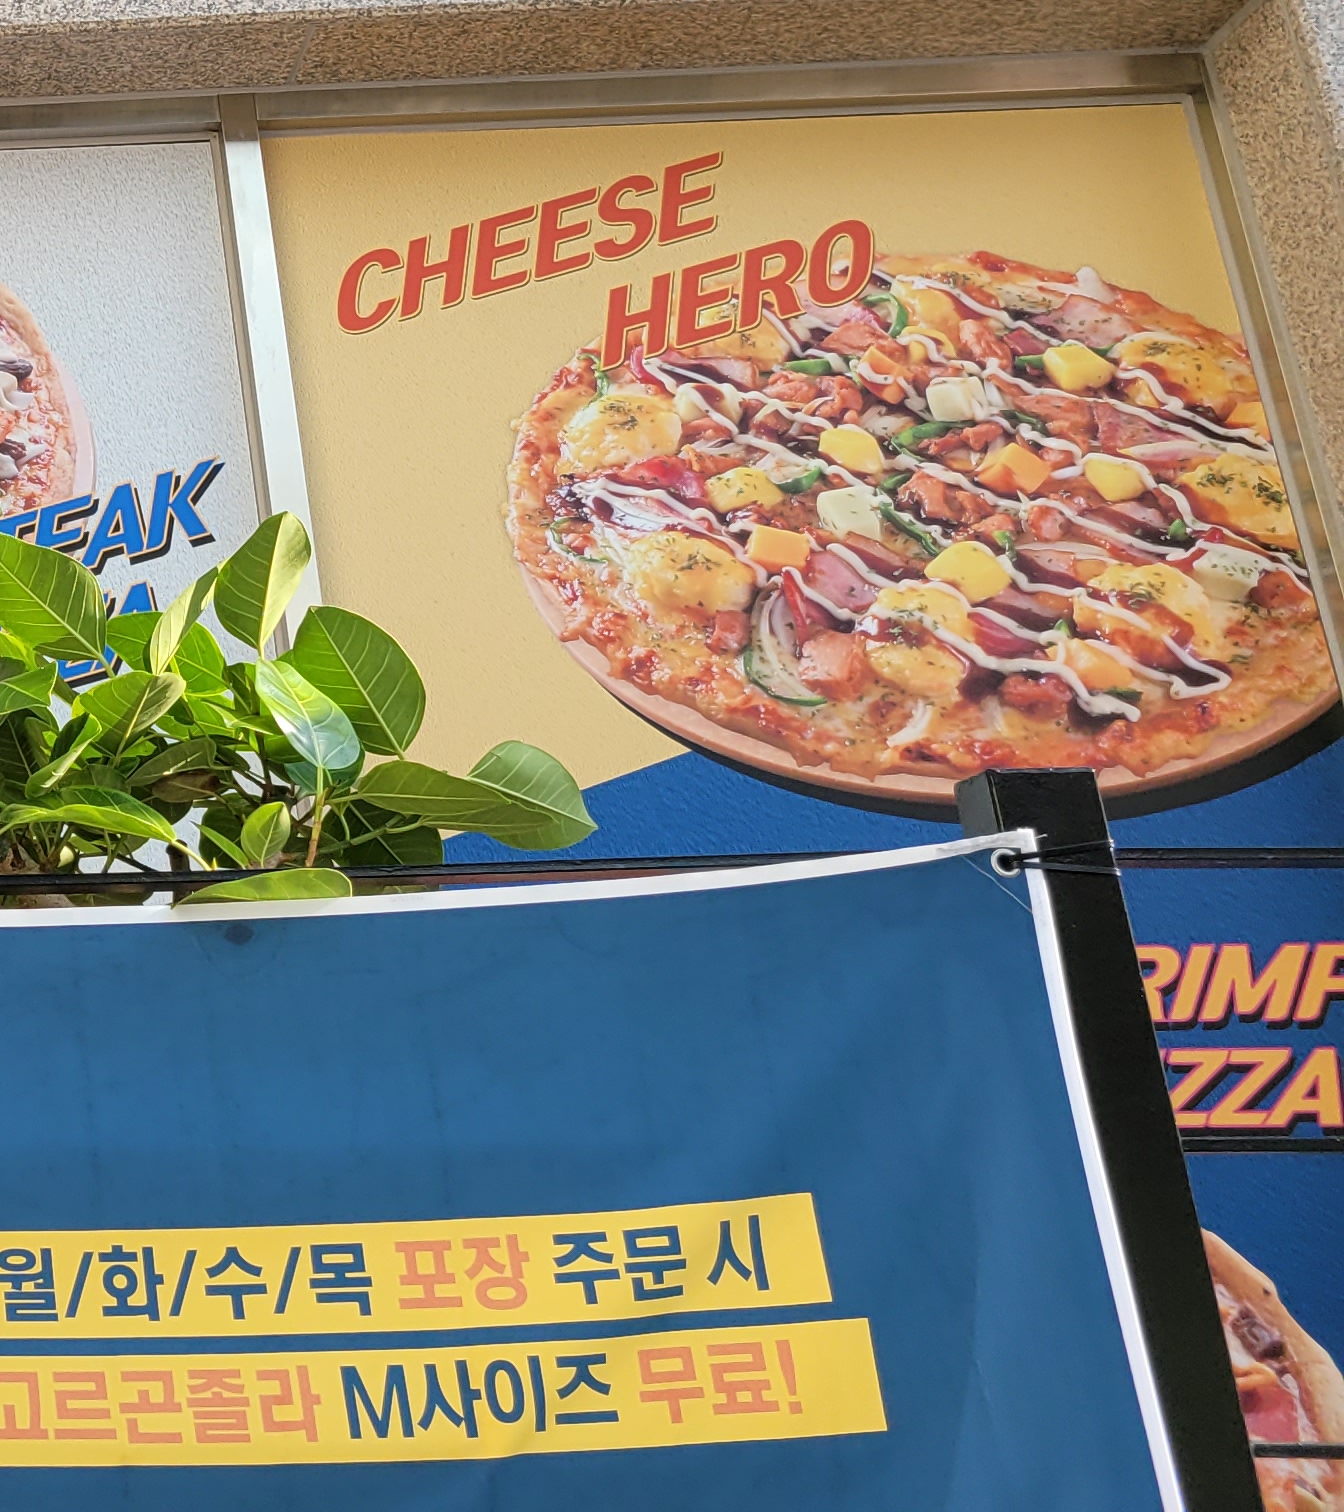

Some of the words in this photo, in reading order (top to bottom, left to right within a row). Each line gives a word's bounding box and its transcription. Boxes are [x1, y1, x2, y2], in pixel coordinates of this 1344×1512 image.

[336, 150, 724, 334] CHEESE
[600, 218, 875, 372] HERO
[1159, 1046, 1344, 1130] ZZA
[394, 1233, 530, 1310] 포장
[552, 1225, 687, 1305] 주문
[706, 1213, 771, 1291] 시
[339, 1352, 620, 1440] M사이즈
[637, 1339, 804, 1425] 무료!
